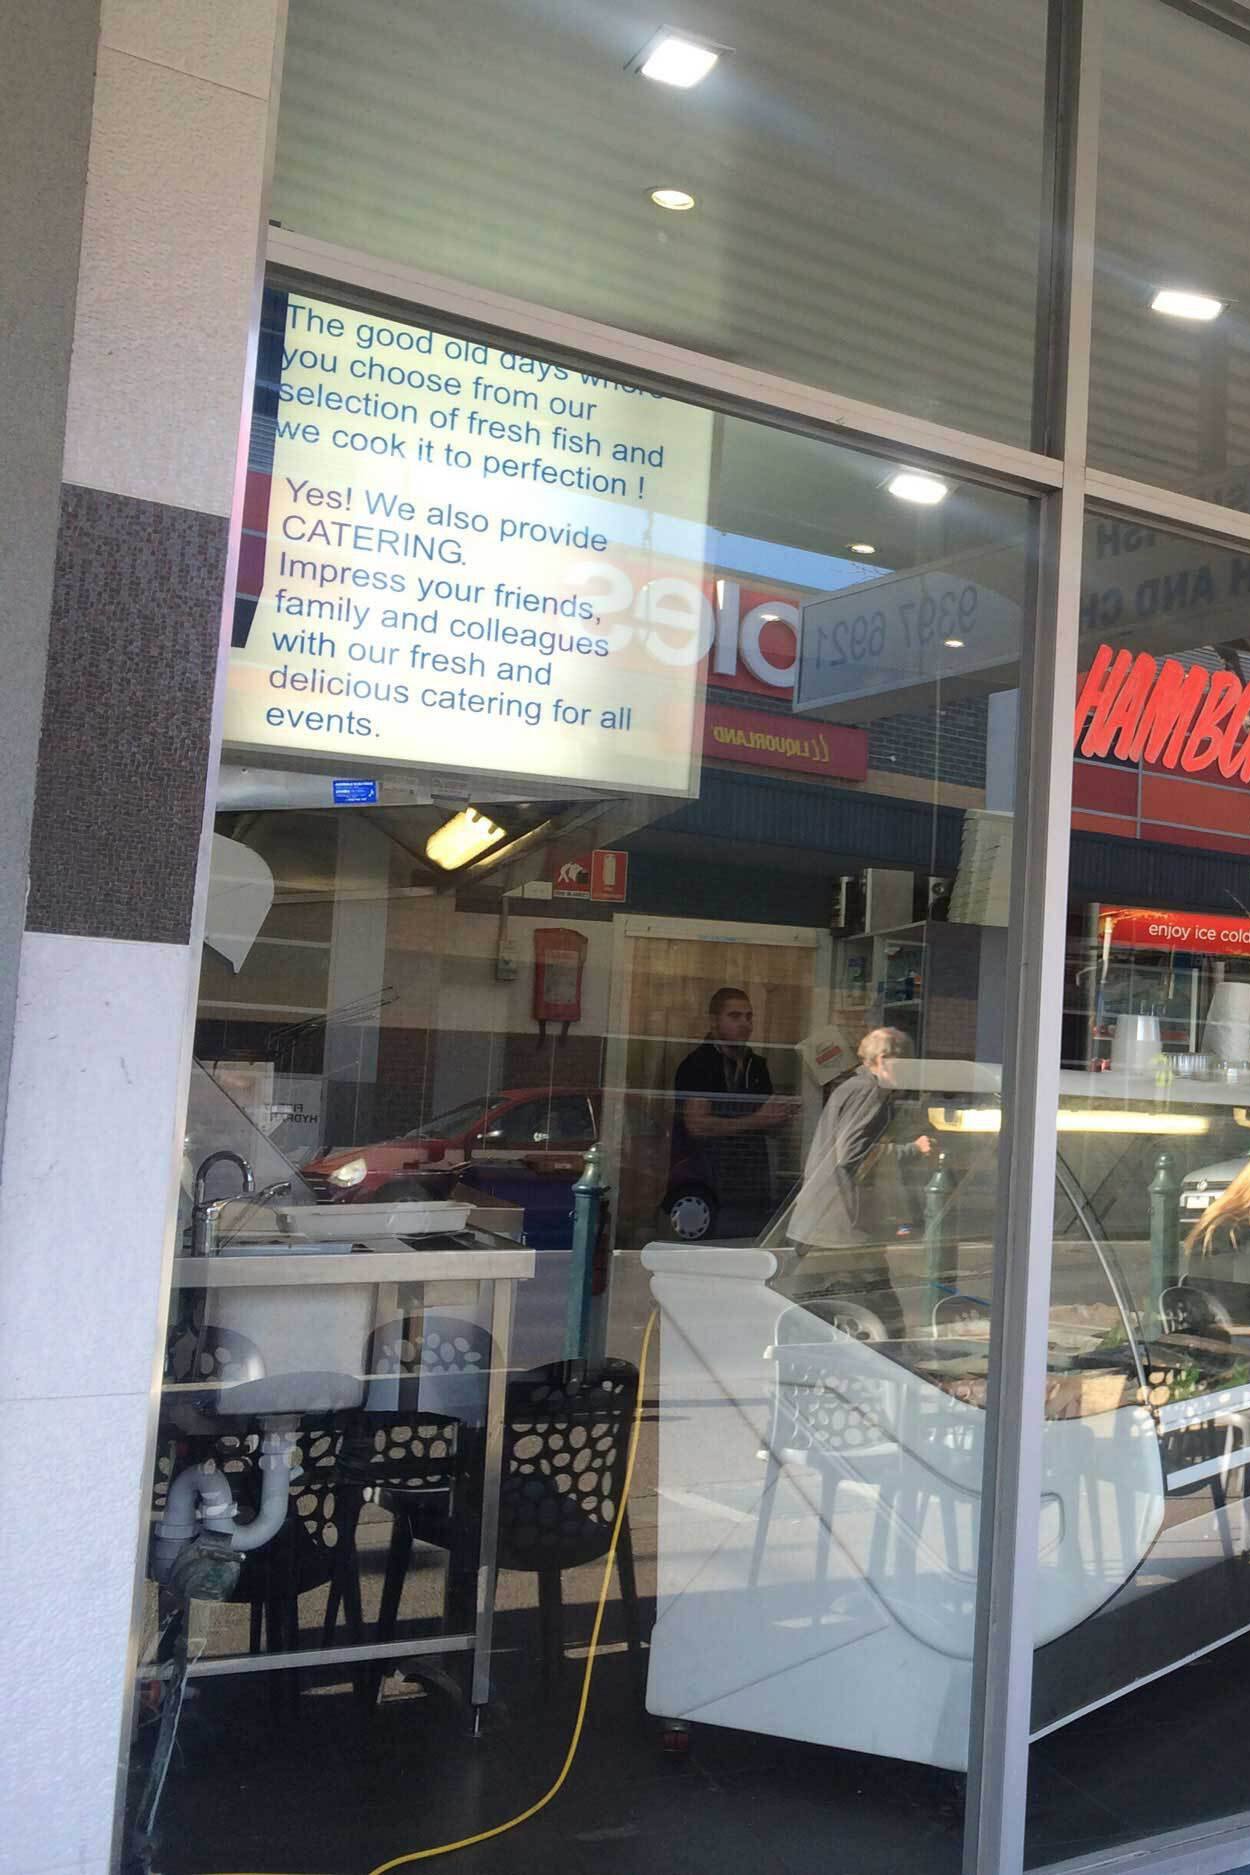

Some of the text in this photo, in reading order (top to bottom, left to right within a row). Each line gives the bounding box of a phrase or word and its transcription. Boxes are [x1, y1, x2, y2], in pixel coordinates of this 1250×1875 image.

[288, 304, 345, 337] The
[356, 323, 433, 355] good
[445, 341, 488, 365] old
[282, 345, 597, 420] you choose from our
[276, 421, 320, 443] we
[332, 429, 406, 458] cook
[417, 437, 434, 463] it
[445, 443, 472, 468] to
[484, 454, 626, 496] perfection
[278, 383, 664, 468] selection of fresh fish and
[282, 515, 466, 566] CATERING.
[286, 477, 608, 552] Yes! We also provide
[279, 551, 601, 625] Impress your friends,
[275, 589, 609, 657] family and colleagues
[272, 630, 552, 686] with our fresh and
[266, 706, 380, 738] events.
[268, 664, 632, 731] delicious catering for all
[1148, 922, 1191, 941] enjoy
[1194, 924, 1216, 942] ice
